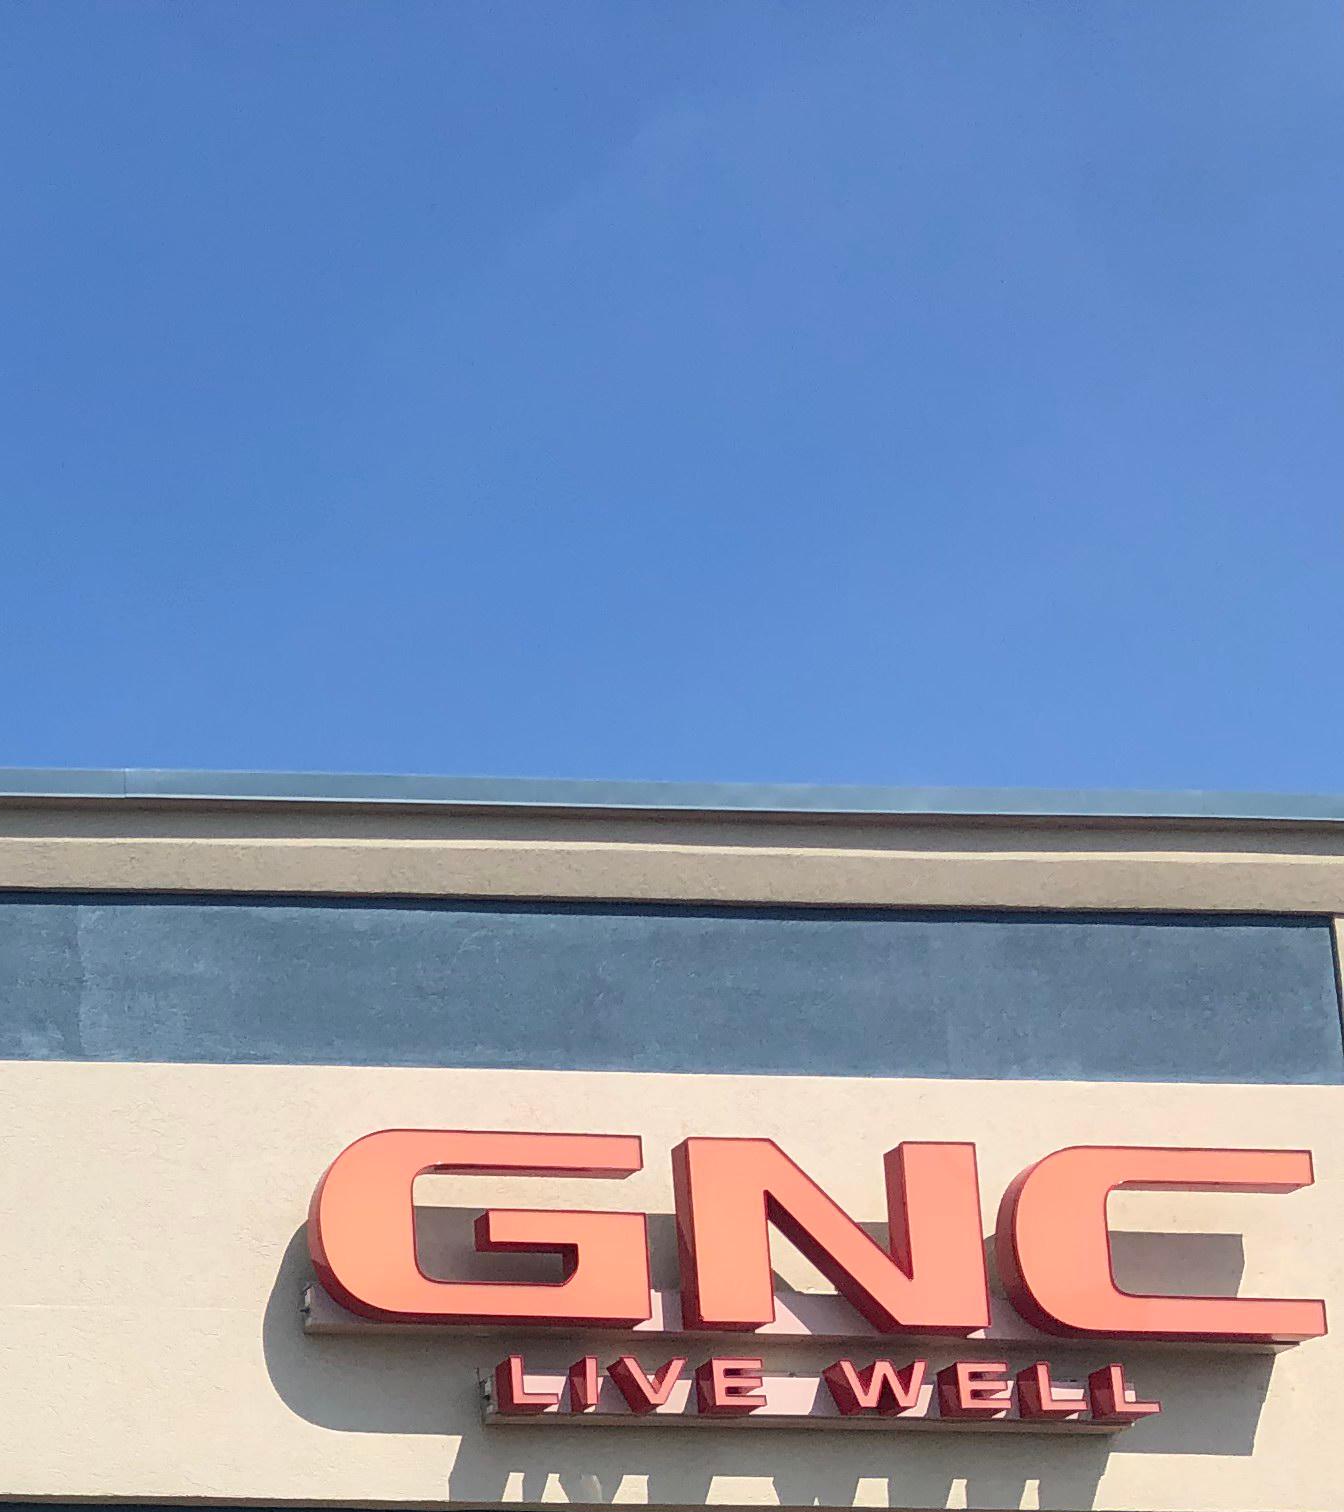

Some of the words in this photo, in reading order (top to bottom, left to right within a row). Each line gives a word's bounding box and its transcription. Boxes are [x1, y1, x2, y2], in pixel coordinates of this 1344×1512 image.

[307, 1128, 1329, 1342] GNC
[496, 1354, 769, 1418] LIVE
[823, 1358, 1162, 1423] WELL
